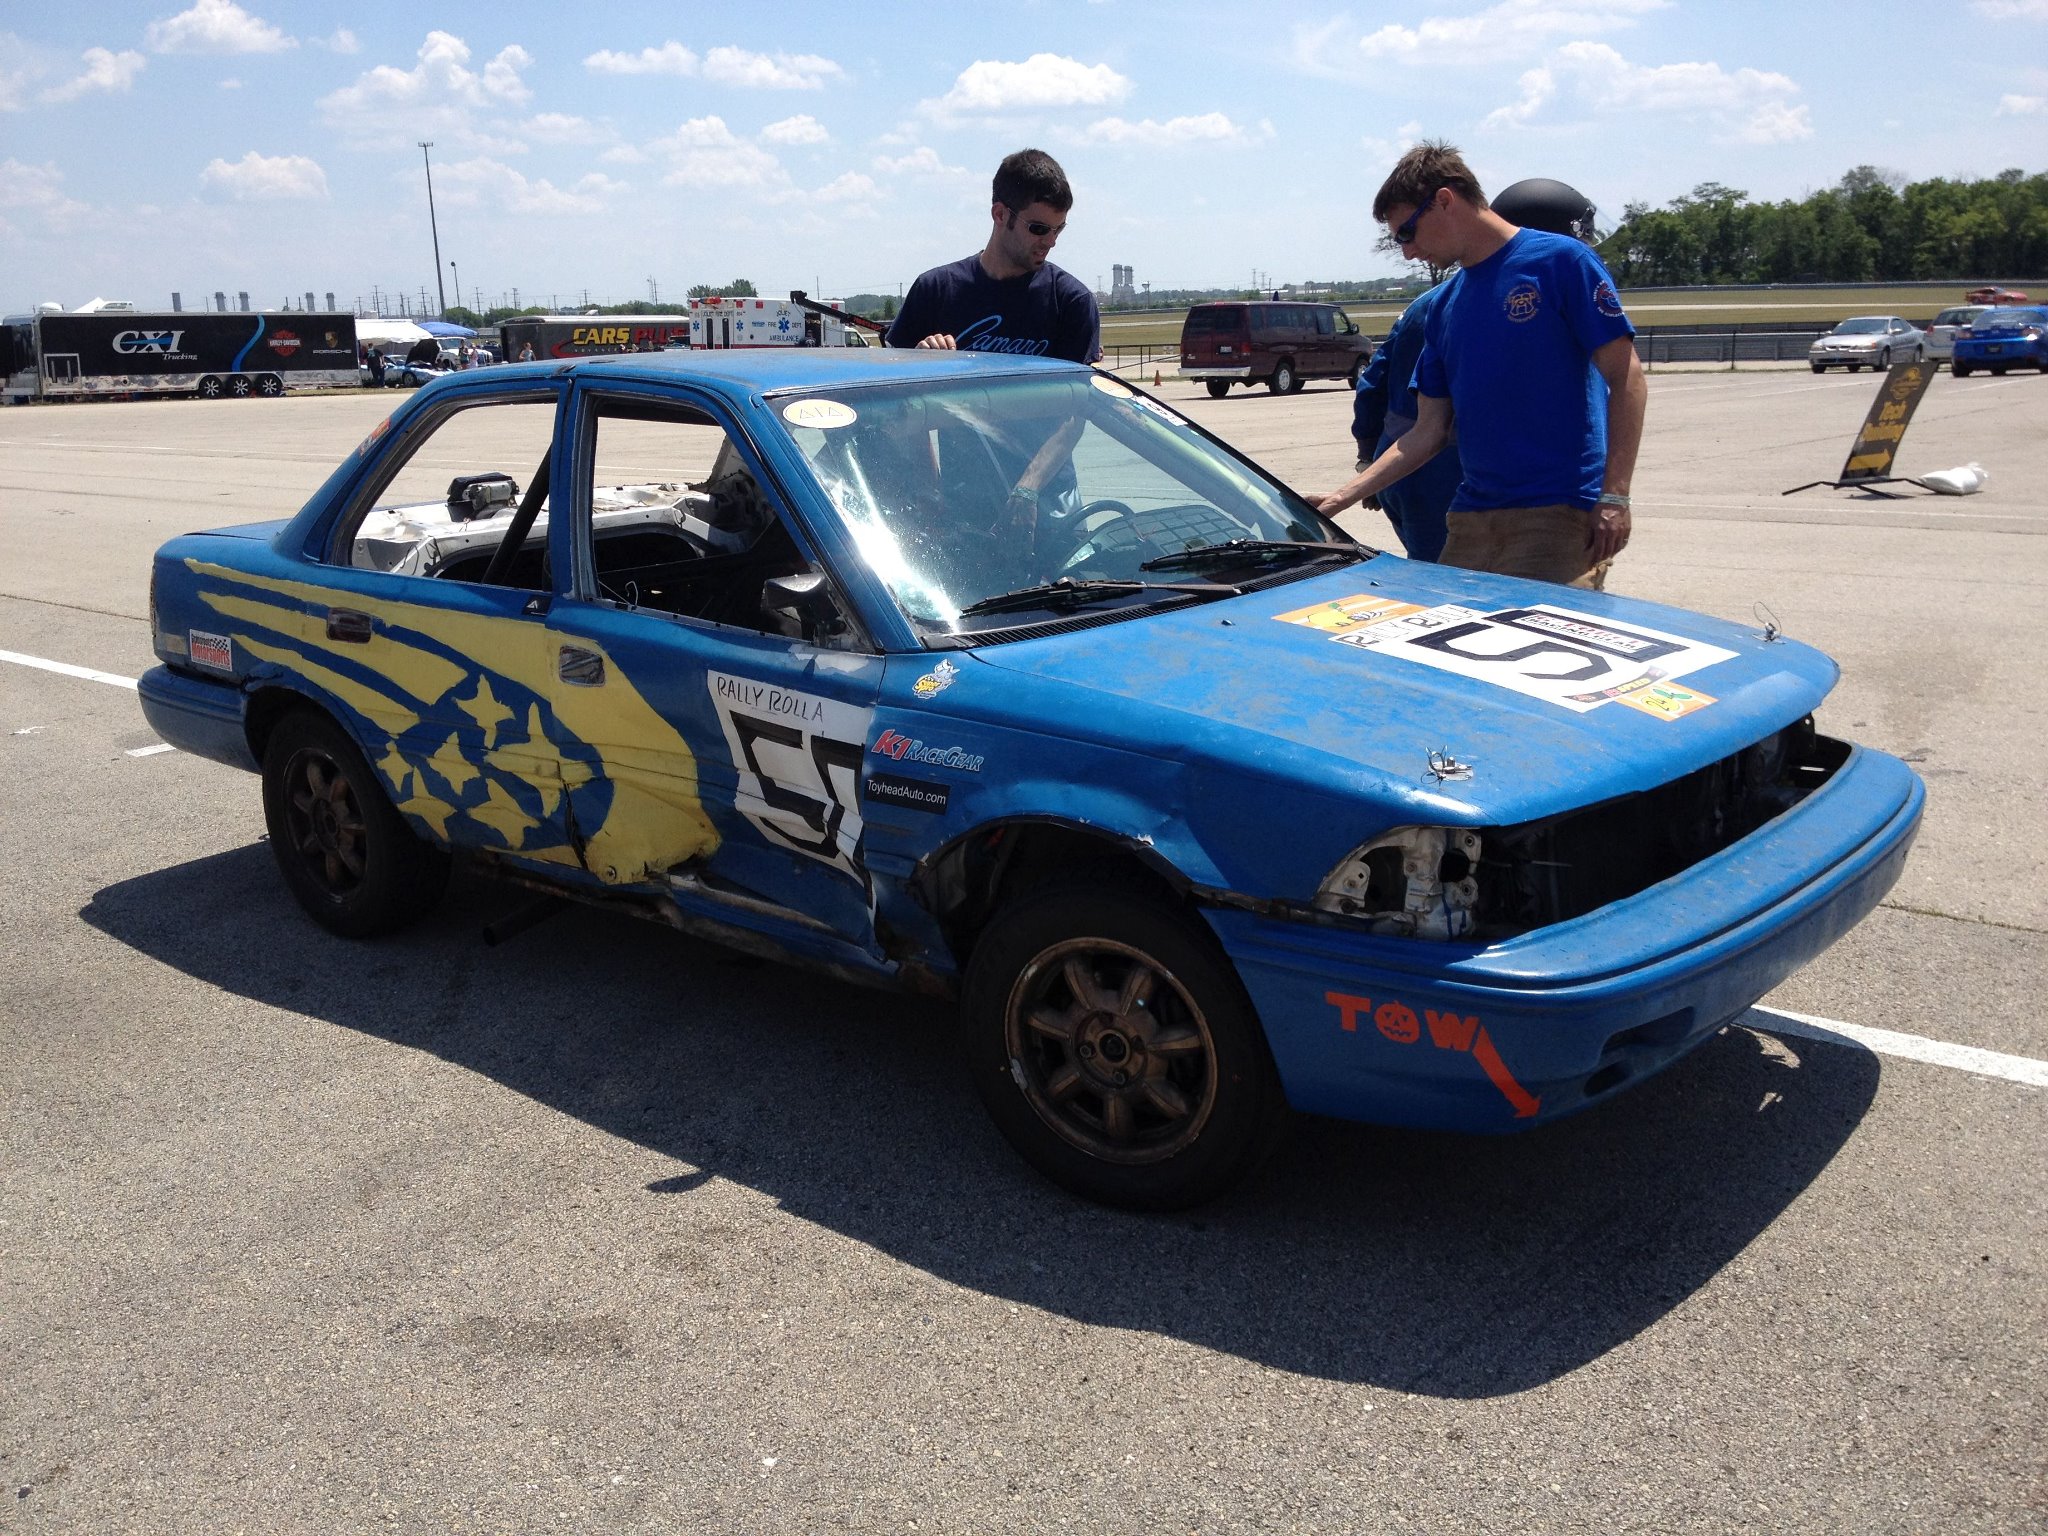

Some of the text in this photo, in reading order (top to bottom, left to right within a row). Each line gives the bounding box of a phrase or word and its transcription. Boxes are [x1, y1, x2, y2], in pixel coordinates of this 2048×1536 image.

[112, 330, 185, 354] CXI
[573, 327, 630, 345] CARS
[716, 676, 824, 723] RALLY ROLLA
[871, 729, 914, 761] K1
[866, 779, 947, 806] ToyheadAuto.com
[1325, 991, 1480, 1051] TOW
